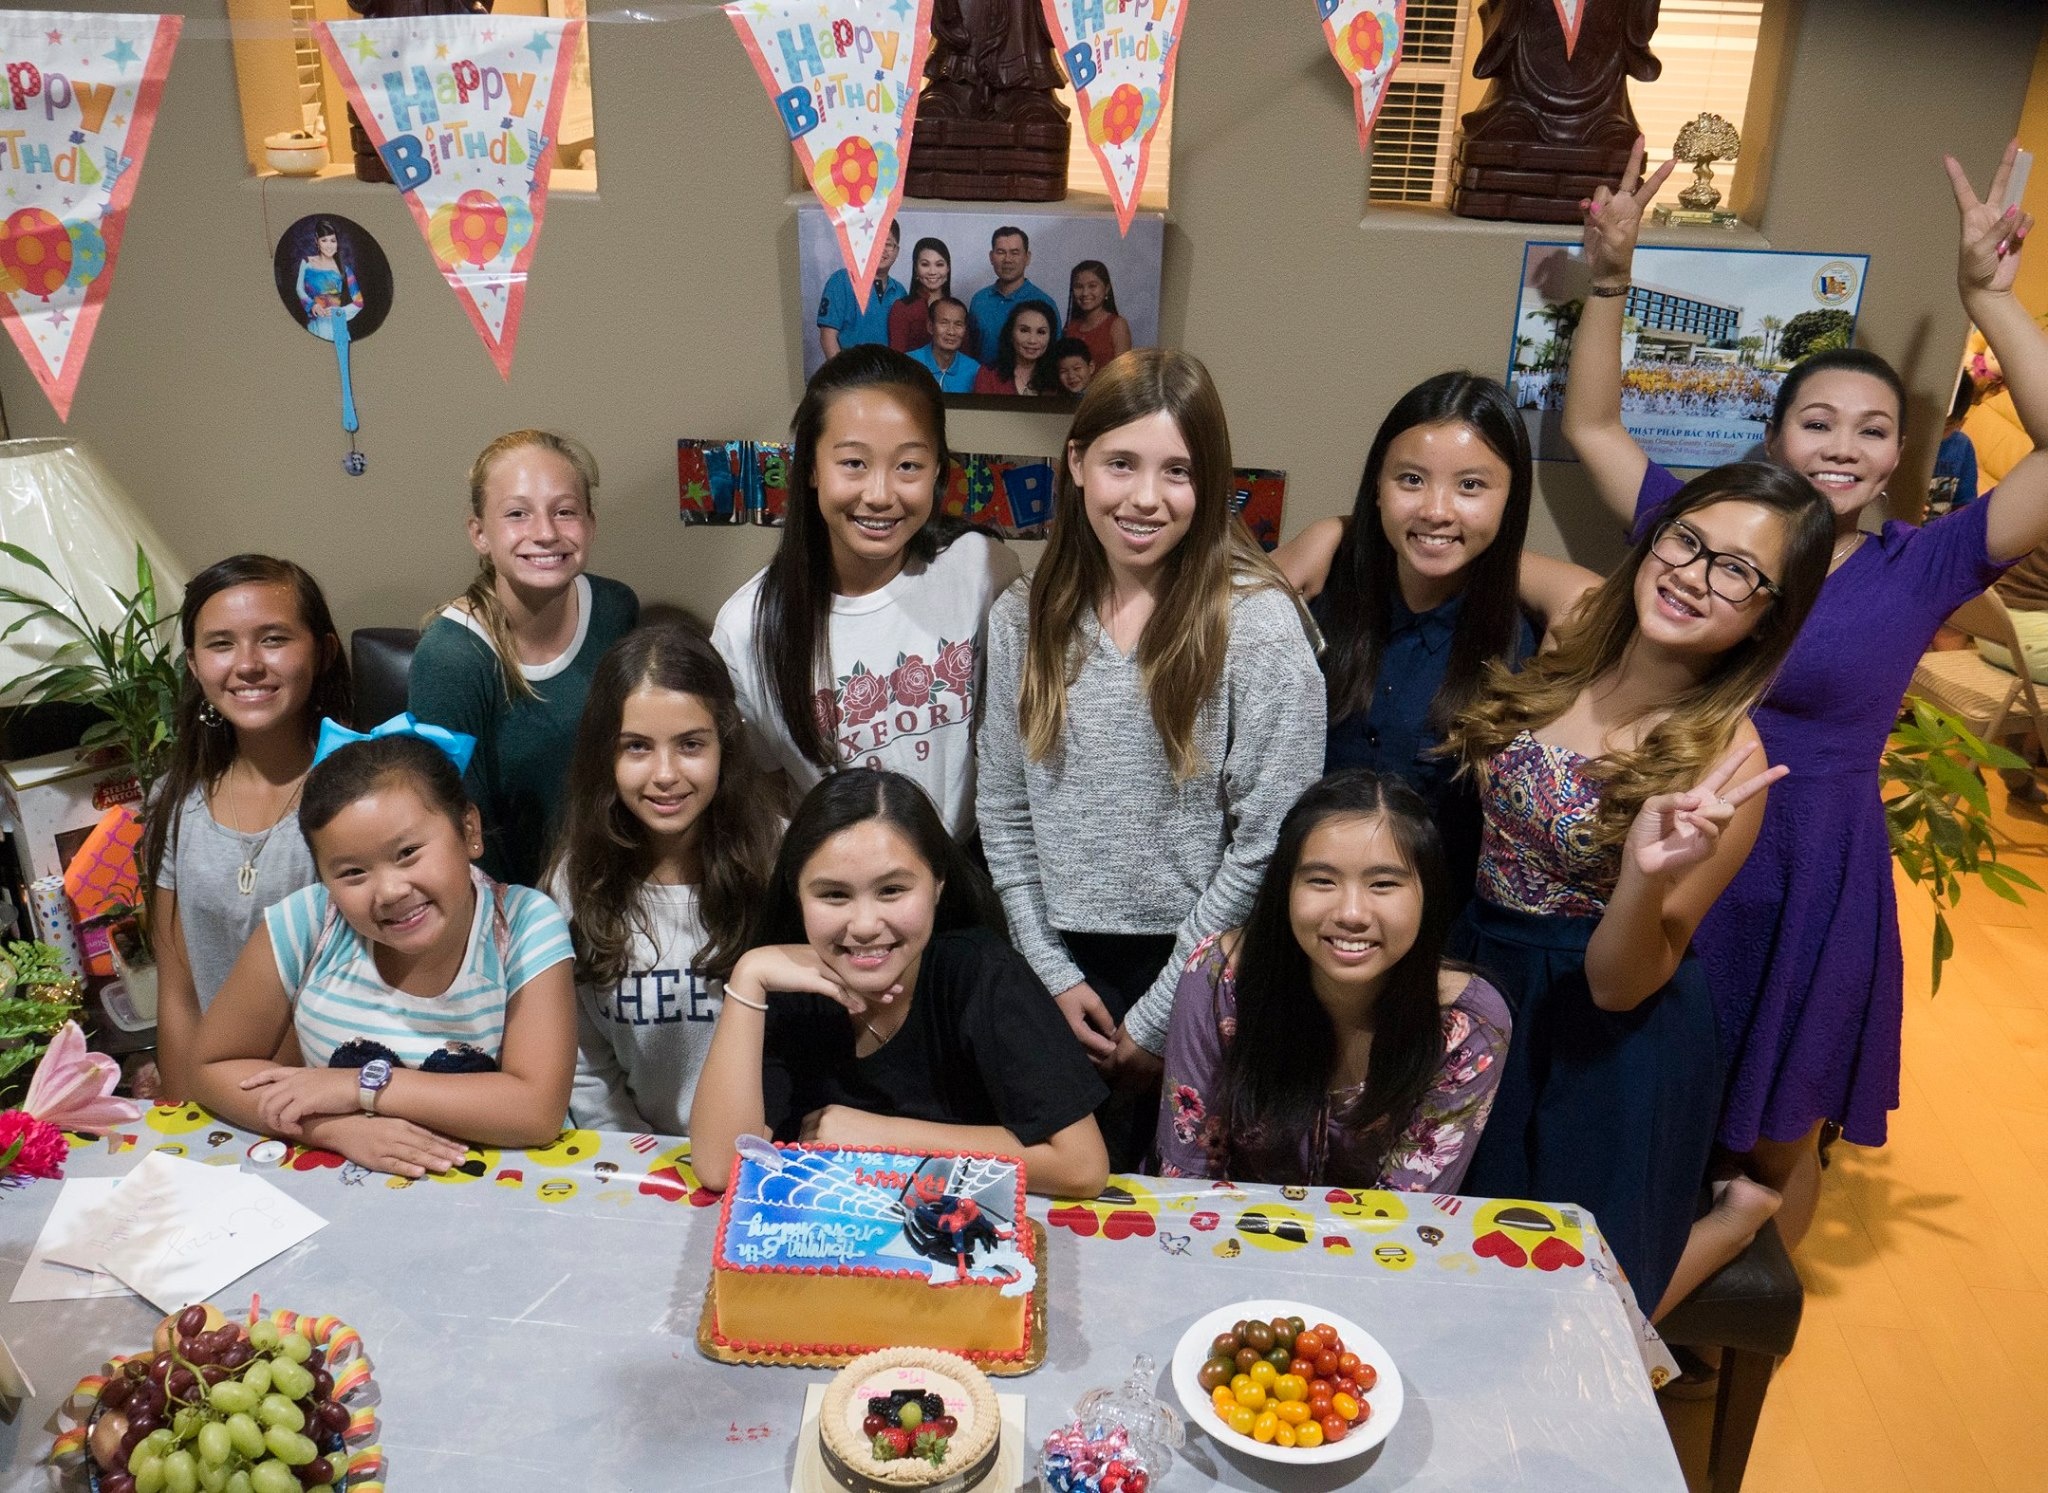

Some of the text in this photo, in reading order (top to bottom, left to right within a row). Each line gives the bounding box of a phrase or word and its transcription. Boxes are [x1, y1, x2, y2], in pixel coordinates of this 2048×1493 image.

[776, 18, 900, 84] Happy
[382, 59, 537, 132] Happy
[102, 780, 141, 797] STELLA
